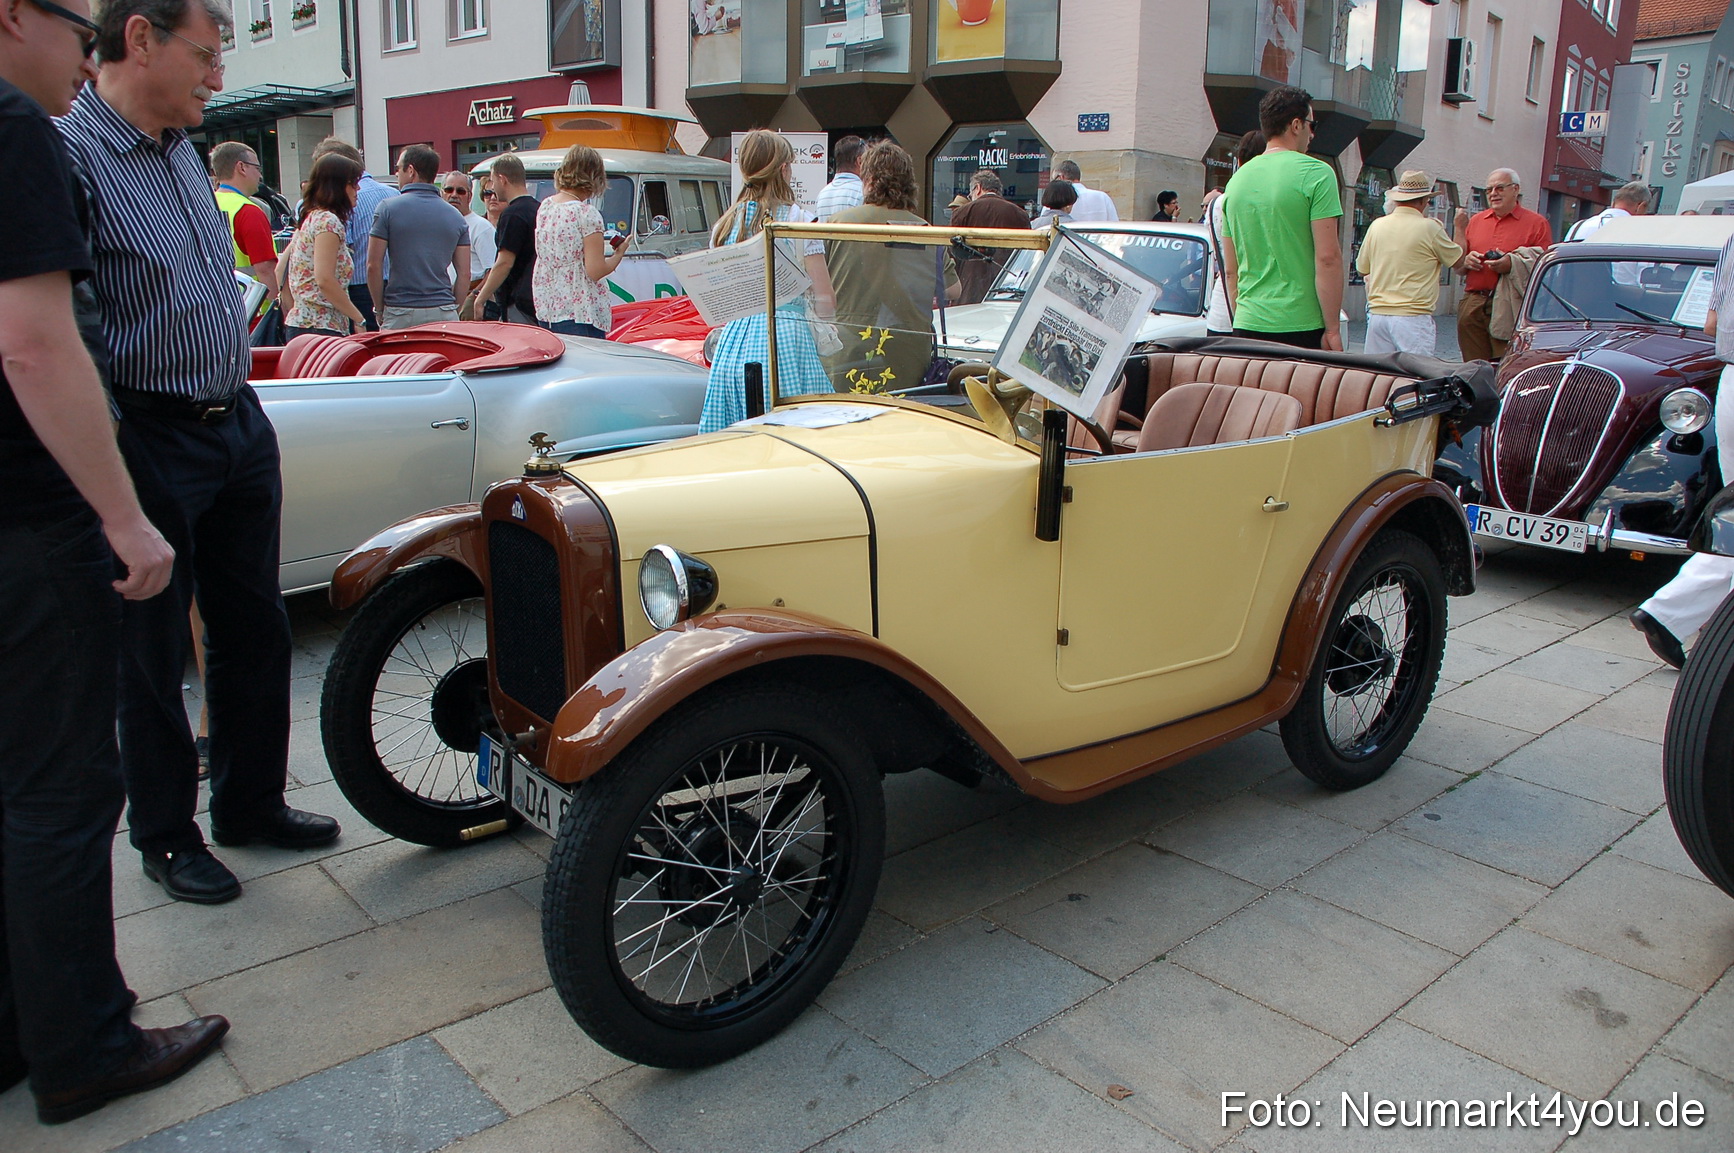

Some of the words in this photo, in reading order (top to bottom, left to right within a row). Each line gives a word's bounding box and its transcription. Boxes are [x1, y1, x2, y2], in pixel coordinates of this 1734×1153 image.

[467, 97, 513, 126] Achatz
[1661, 61, 1690, 176] satzke
[979, 148, 1008, 165] RACKL
[1477, 511, 1492, 532] R
[1506, 516, 1537, 539] CV
[1540, 521, 1570, 545] 39
[525, 774, 551, 830] DA
